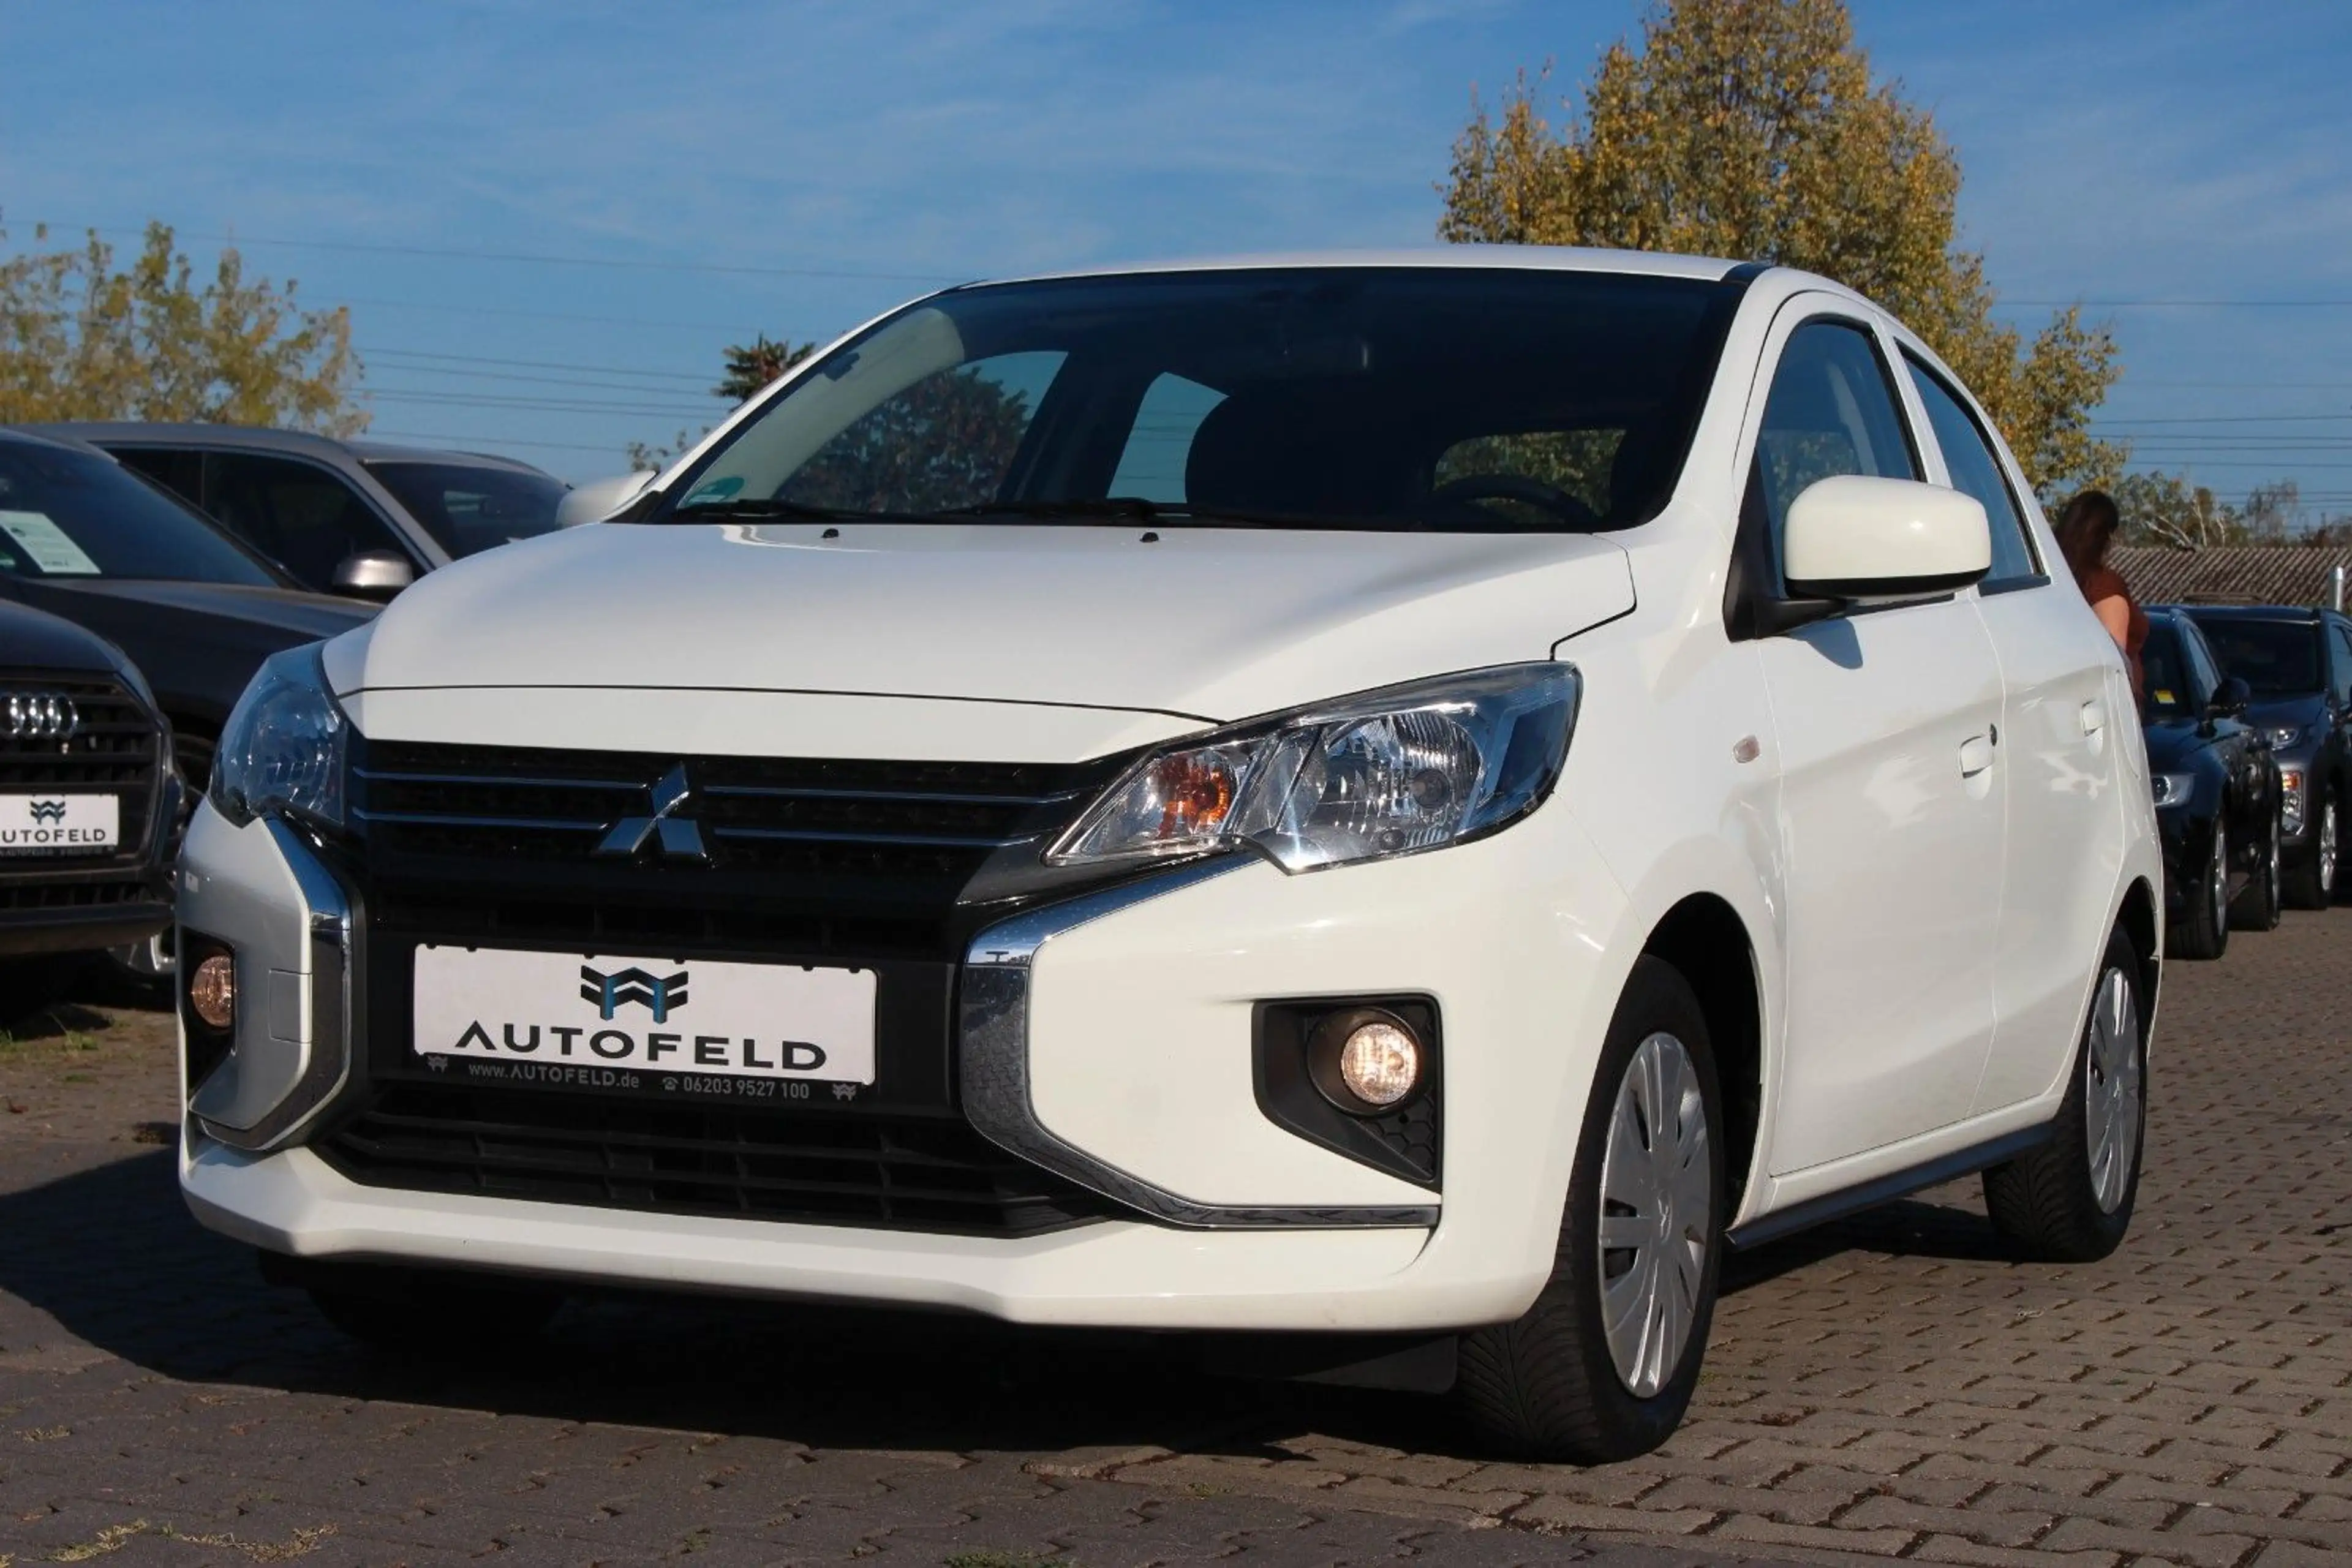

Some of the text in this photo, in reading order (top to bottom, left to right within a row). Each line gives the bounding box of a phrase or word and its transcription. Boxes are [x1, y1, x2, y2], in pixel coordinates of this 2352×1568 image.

[0, 829, 106, 843] UTOFELD
[455, 1020, 827, 1071] AUTOFELD
[468, 1064, 810, 1099] www.AUTOFELD.de 06203 9527 100
